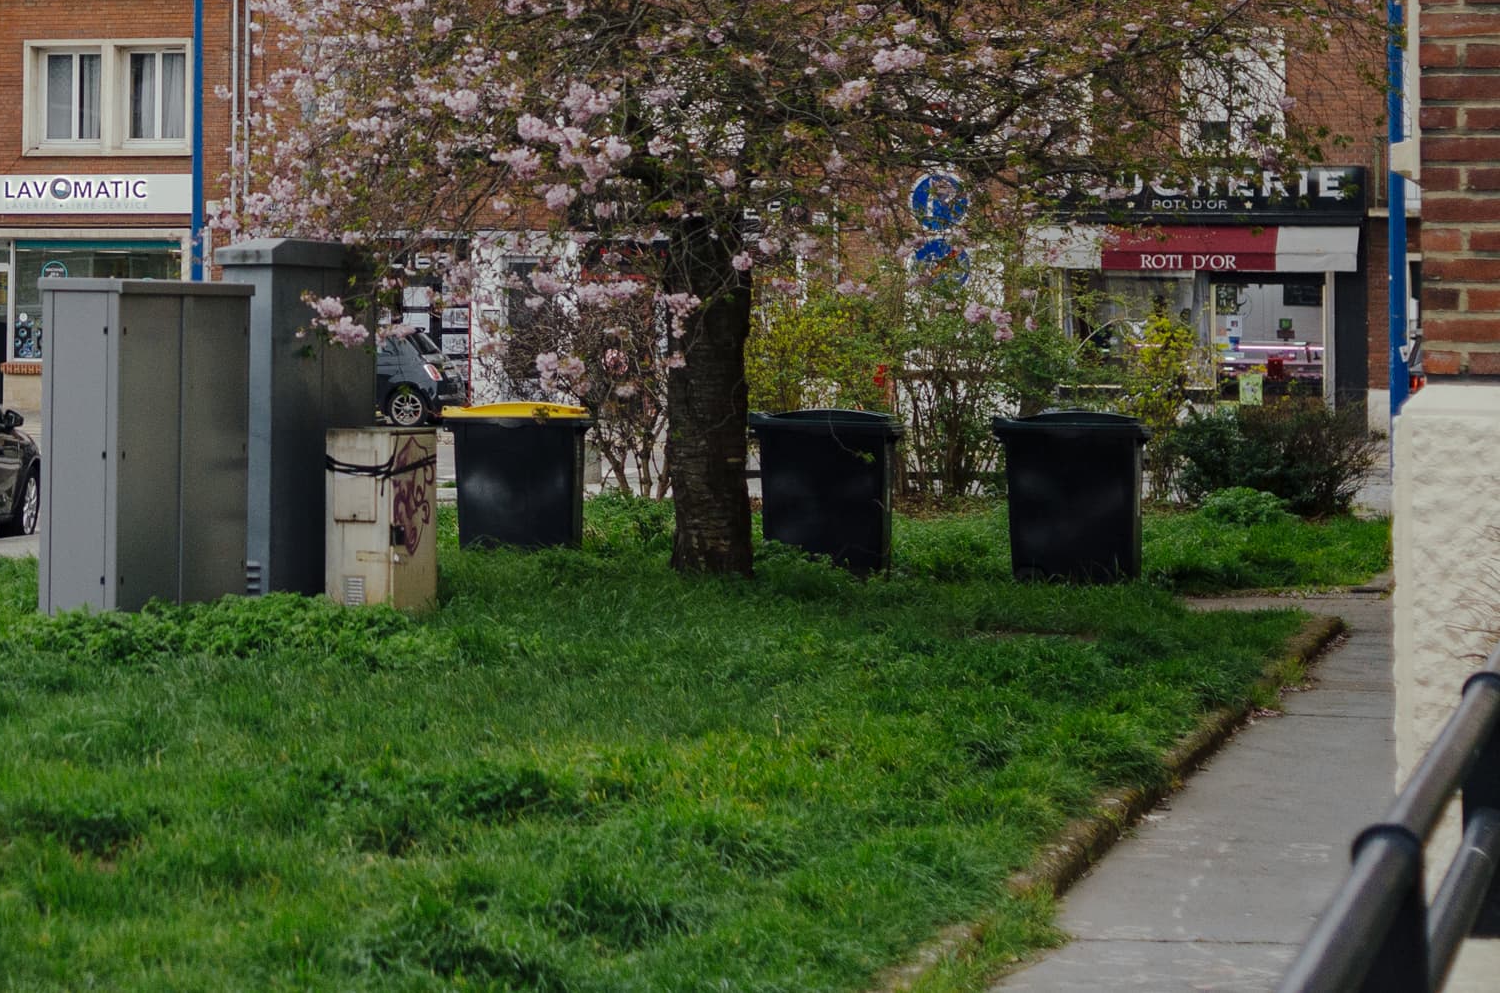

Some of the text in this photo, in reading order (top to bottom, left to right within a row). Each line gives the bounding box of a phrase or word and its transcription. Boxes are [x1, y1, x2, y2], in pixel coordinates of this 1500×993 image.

[5, 178, 147, 200] LAVOMATIC
[1192, 199, 1227, 210] D'OR
[1140, 254, 1236, 269] ROTI D'OR
